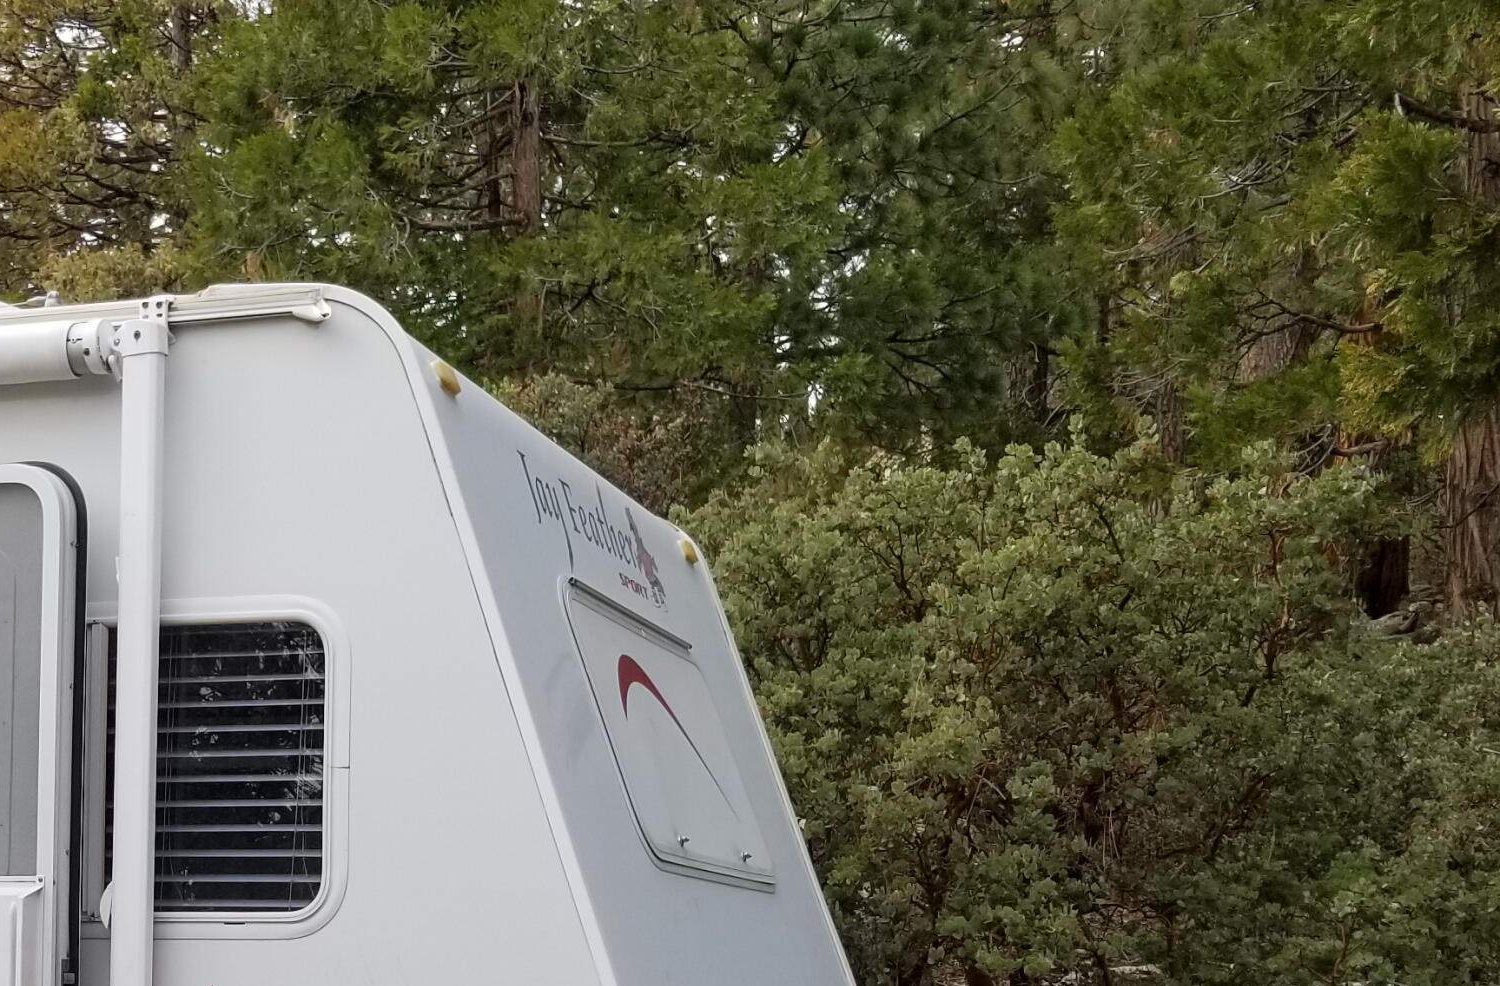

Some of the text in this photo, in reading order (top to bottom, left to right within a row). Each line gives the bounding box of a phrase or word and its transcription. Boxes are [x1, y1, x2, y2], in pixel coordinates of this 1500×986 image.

[516, 449, 637, 573] Jay Feather
[618, 571, 649, 600] SPORT
